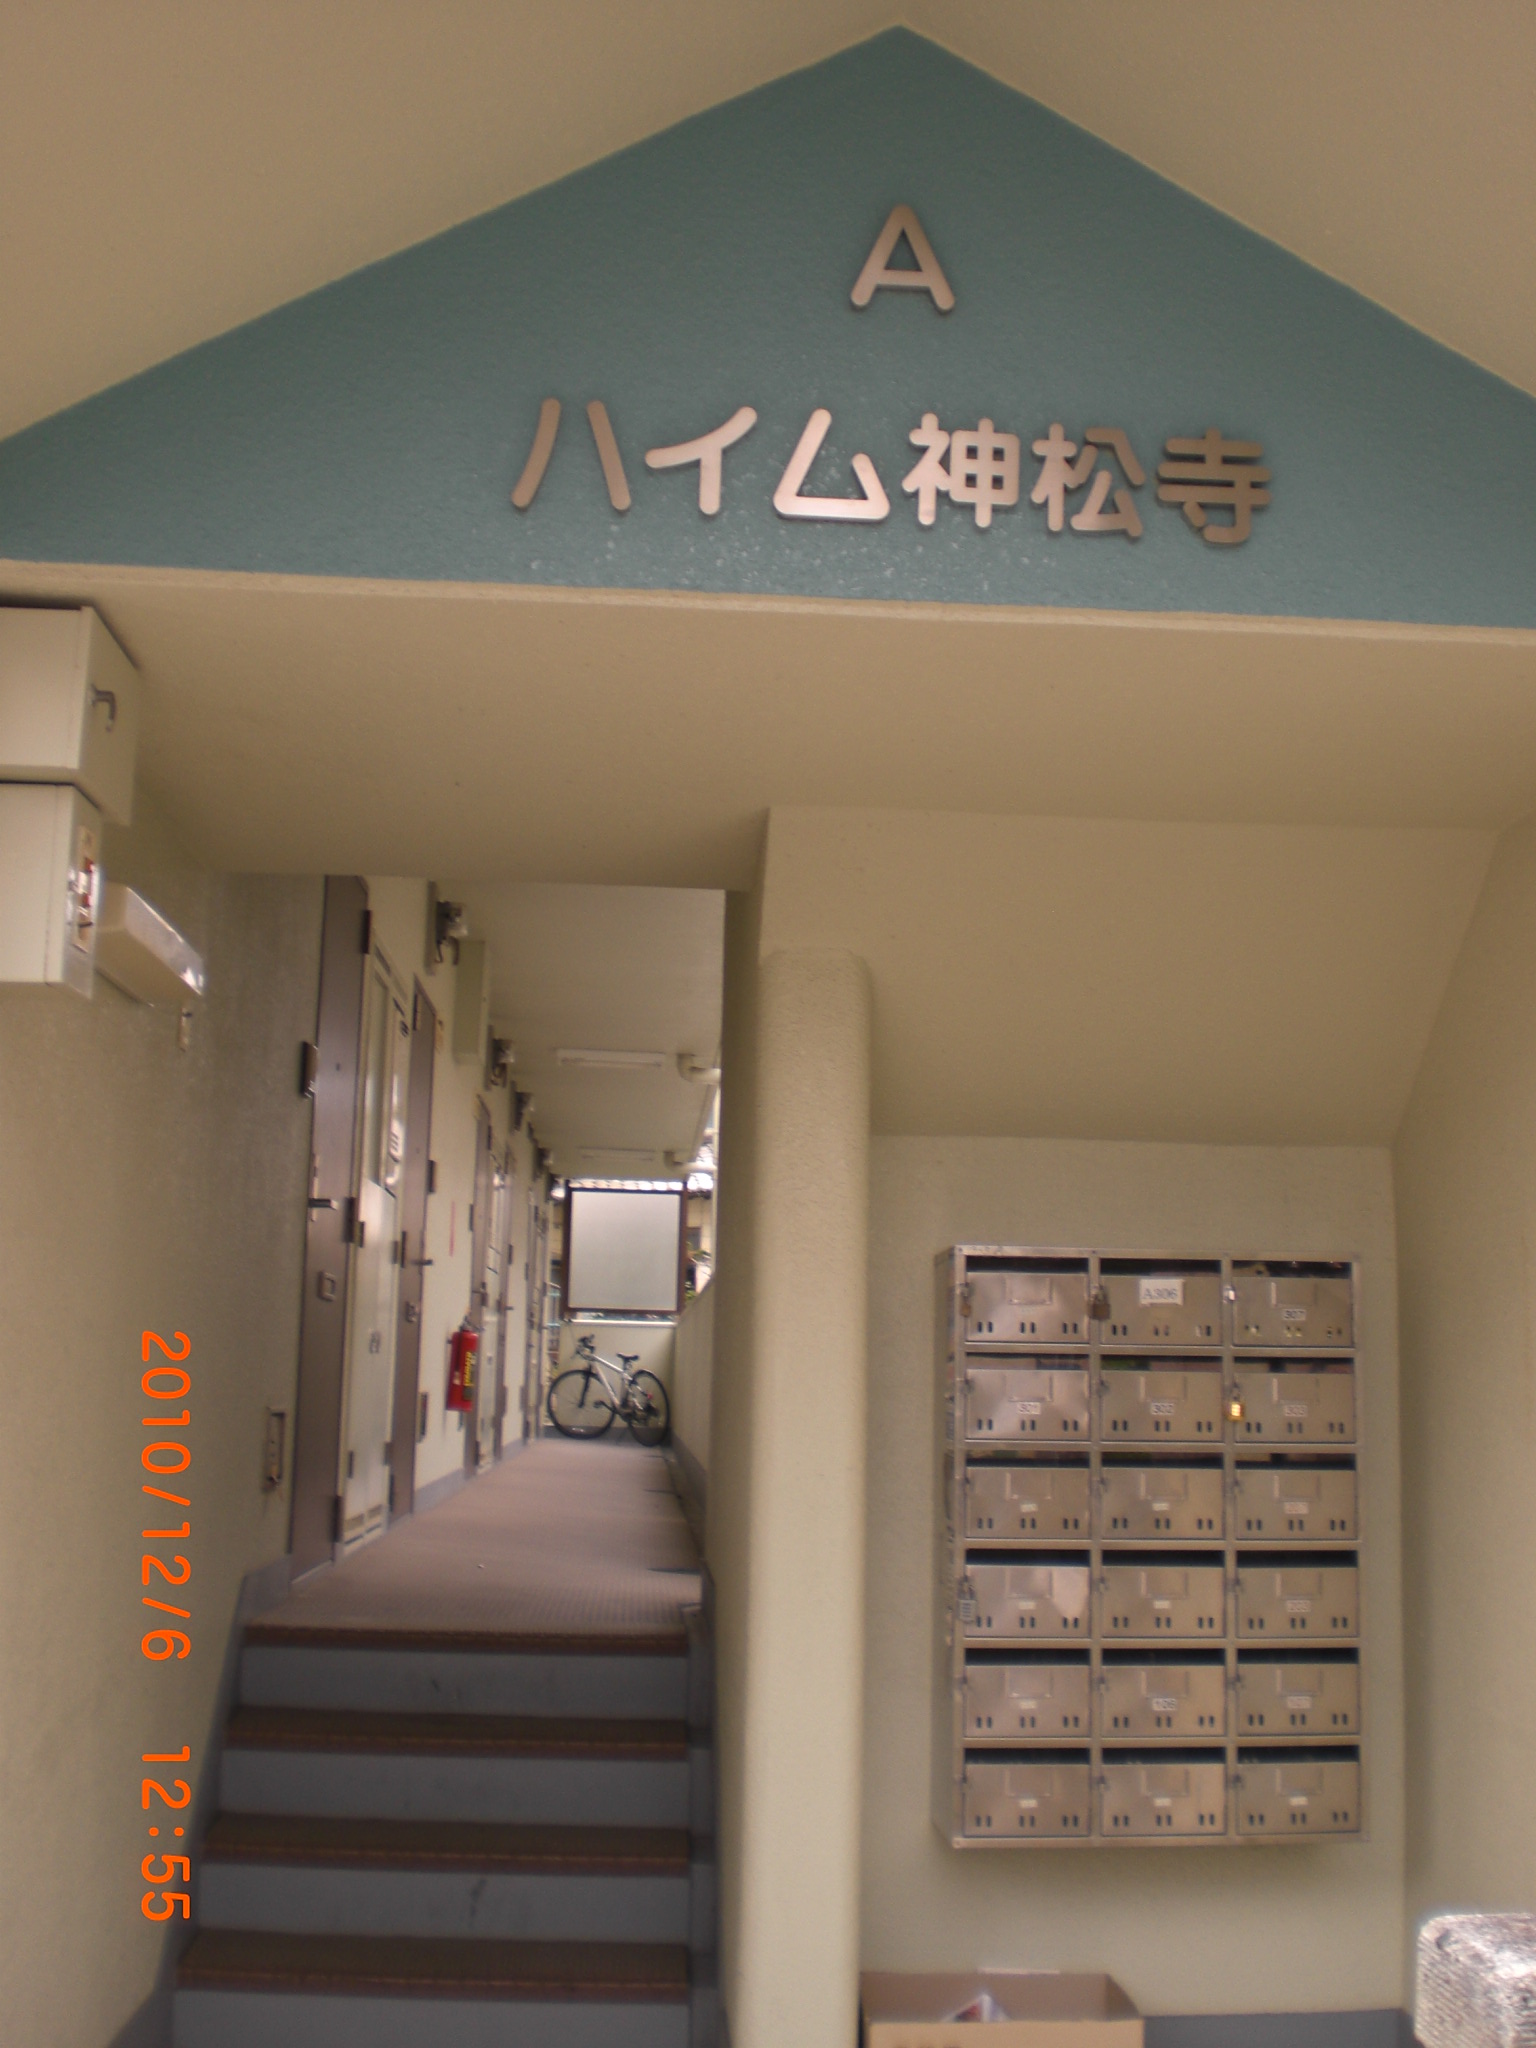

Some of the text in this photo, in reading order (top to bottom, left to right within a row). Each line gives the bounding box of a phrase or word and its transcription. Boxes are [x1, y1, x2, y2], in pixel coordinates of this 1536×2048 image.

[850, 204, 956, 311] A
[511, 398, 1272, 545] ハイム神松寺
[1143, 1287, 1178, 1300] A306
